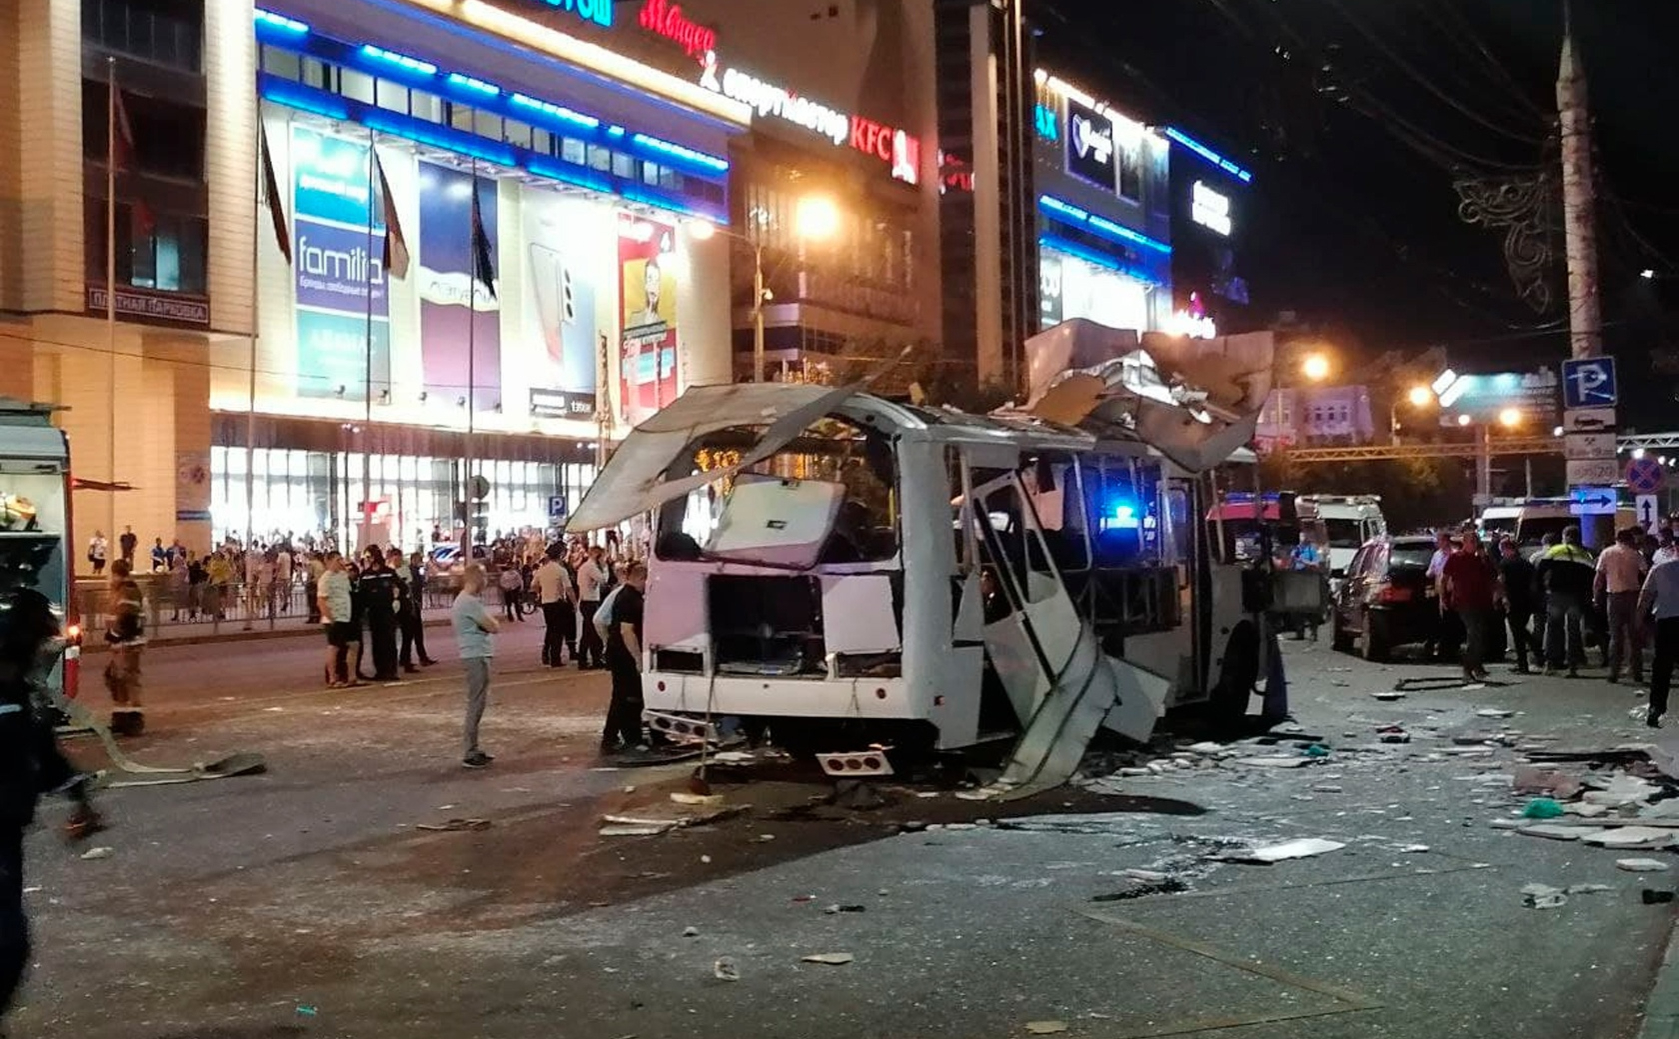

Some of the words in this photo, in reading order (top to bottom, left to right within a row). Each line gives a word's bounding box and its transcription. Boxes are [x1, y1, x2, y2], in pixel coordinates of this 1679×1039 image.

[851, 115, 892, 160] KFC
[299, 236, 384, 285] familia
[552, 498, 563, 515] P
